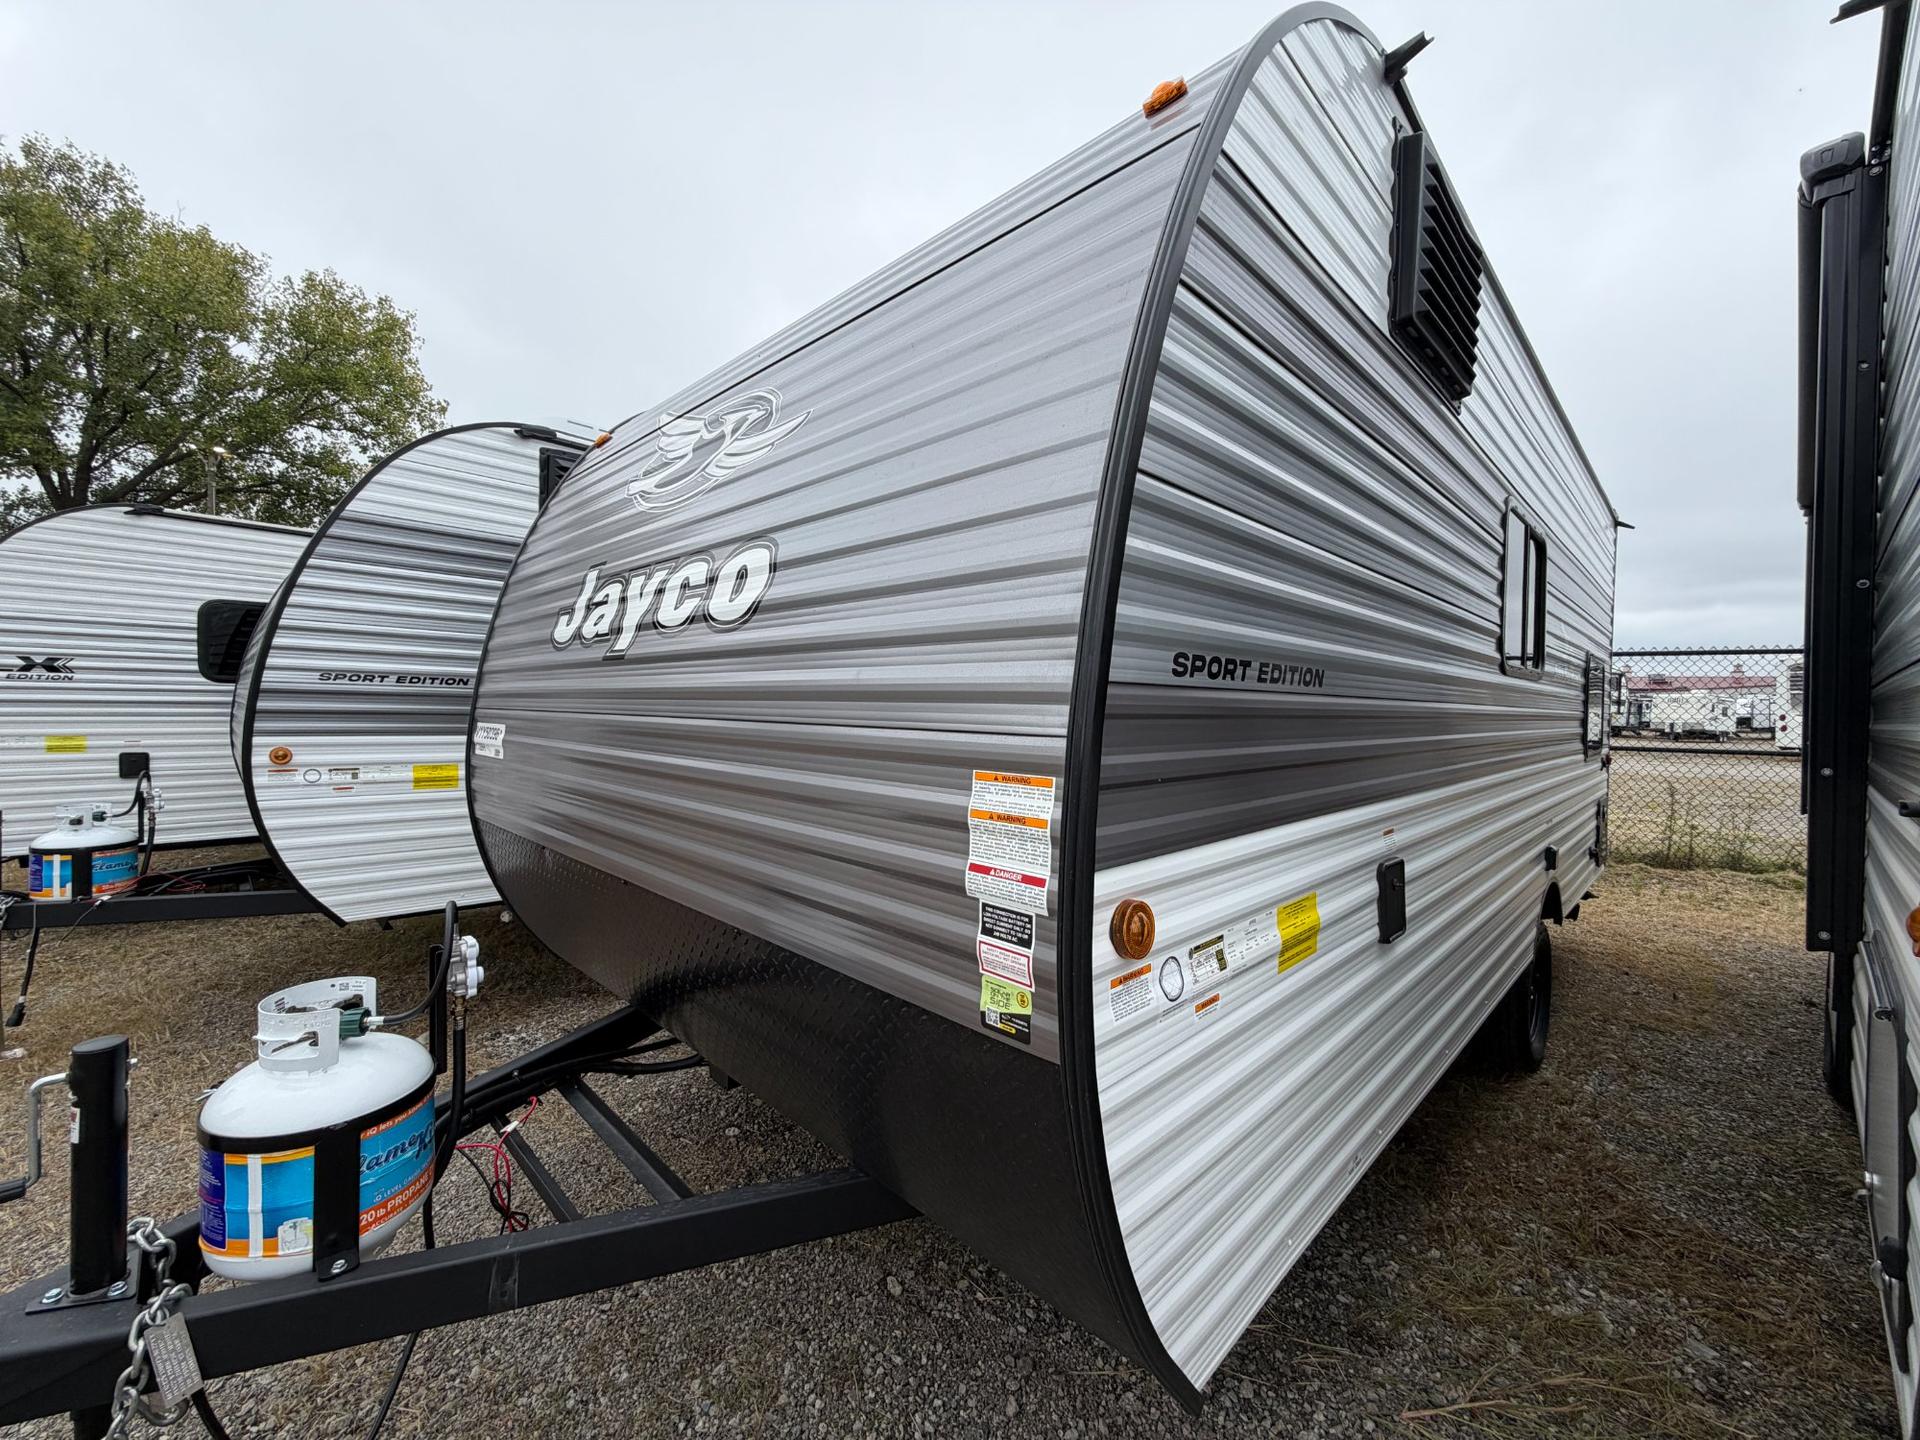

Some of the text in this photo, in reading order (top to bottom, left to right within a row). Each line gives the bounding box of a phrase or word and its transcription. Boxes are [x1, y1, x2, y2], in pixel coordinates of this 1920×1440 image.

[552, 539, 777, 660] Jayco
[1172, 652, 1325, 688] SPORT EDITION
[6, 673, 74, 681] EDITION
[318, 672, 470, 686] SPORT EDITION
[1001, 775, 1031, 785] WARNING
[996, 813, 1026, 825] WARNING
[995, 869, 1023, 882] DANGER
[360, 1211, 376, 1226] 20
